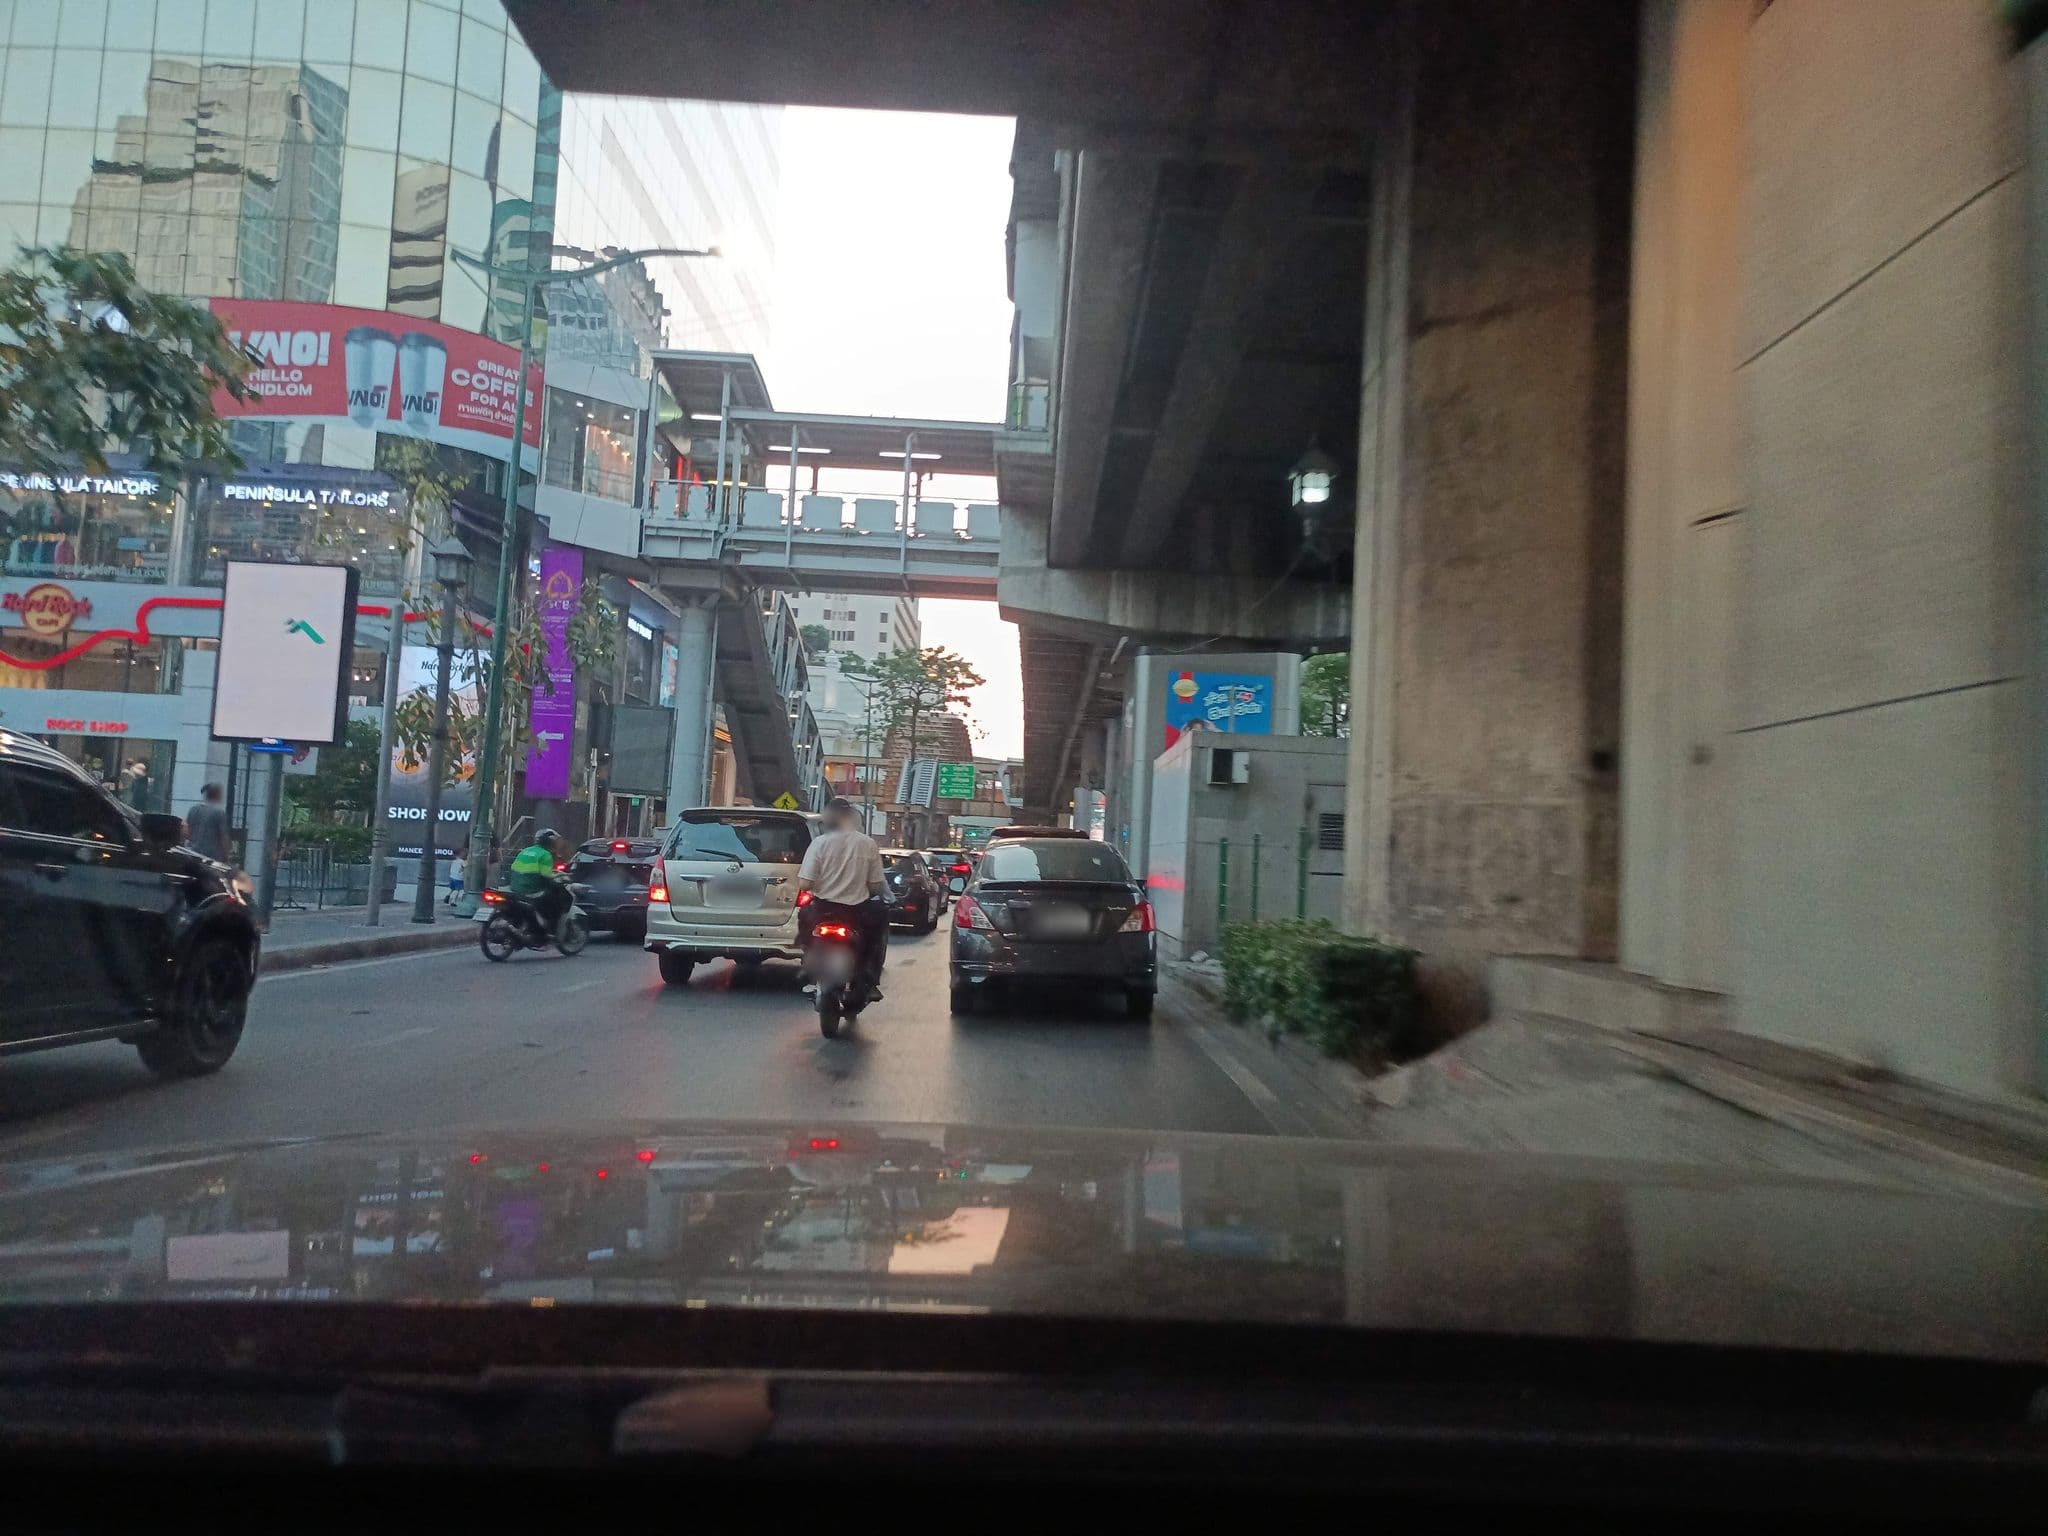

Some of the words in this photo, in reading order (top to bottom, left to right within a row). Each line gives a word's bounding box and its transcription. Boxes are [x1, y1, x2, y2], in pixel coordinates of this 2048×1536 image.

[242, 383, 313, 396] HIDLOM
[451, 368, 534, 407] COFFE
[470, 391, 498, 409] FOR
[94, 477, 160, 496] TAILORS
[225, 484, 316, 503] PENINSULA
